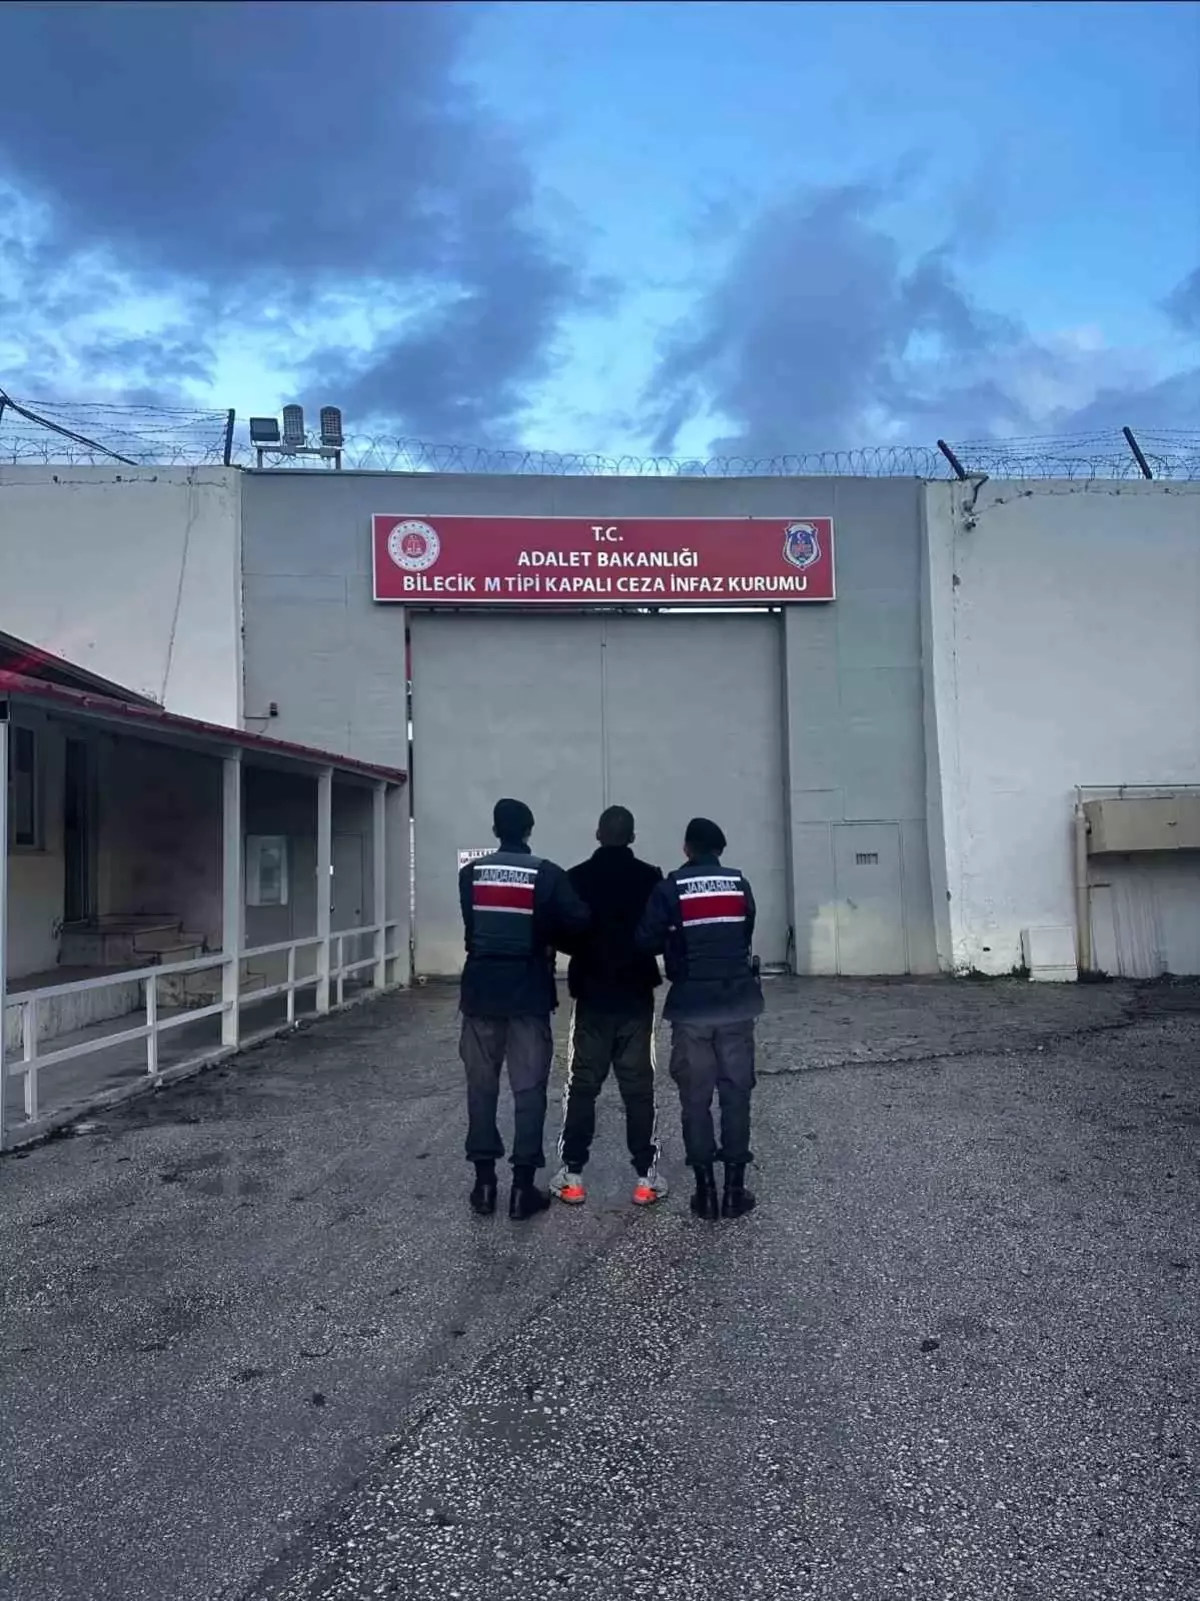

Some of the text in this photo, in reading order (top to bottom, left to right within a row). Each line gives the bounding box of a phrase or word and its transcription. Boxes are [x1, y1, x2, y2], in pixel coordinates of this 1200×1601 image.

[591, 526, 624, 542] T.C.
[518, 547, 699, 568] ADALET BAKANLIĞI
[403, 573, 808, 593] BİLECİK M TİPİ KAPALI CEZA İNFAZ KURUMU
[478, 868, 530, 884] JANDARMA
[685, 880, 737, 894] JANDARMA
